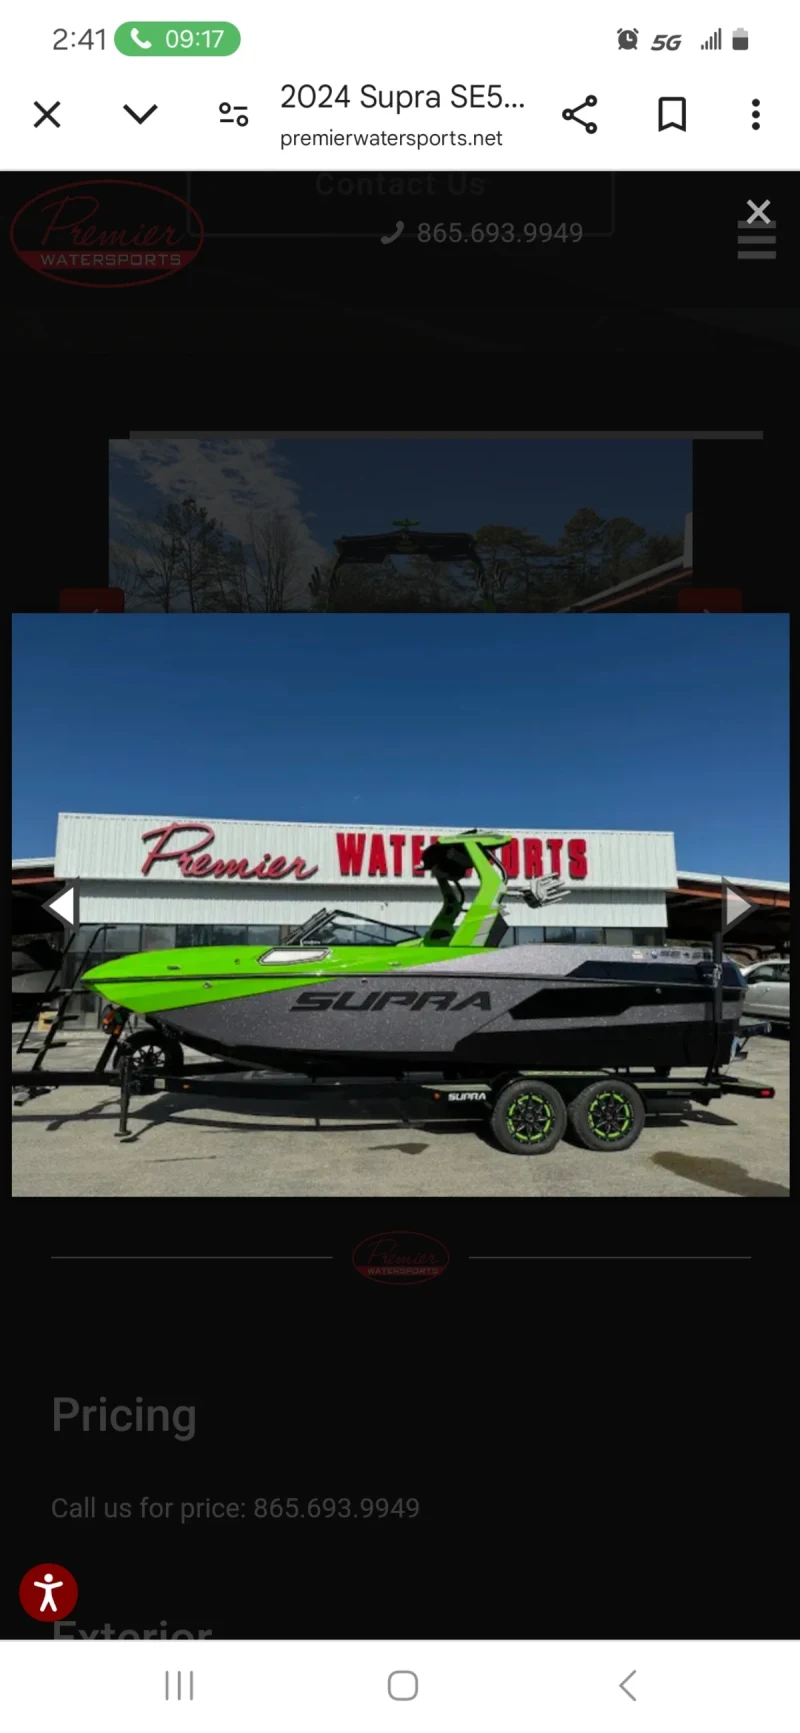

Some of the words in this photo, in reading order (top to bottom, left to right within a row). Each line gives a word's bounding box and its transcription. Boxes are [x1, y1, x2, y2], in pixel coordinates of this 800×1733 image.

[52, 28, 107, 52] 2:41
[165, 29, 225, 49] 09:17
[651, 33, 682, 52] 5G
[280, 84, 351, 109] 2024
[360, 83, 441, 115] Supra
[280, 129, 503, 151] premierwatersports.net
[315, 172, 436, 197] Contact
[447, 172, 486, 197] Us
[40, 196, 186, 248] Premier
[416, 222, 584, 243] 865.693.9949
[39, 251, 182, 267] WATERSPORTS
[140, 822, 318, 880] Premier
[335, 831, 588, 879] WATEORTS
[289, 990, 493, 1012] SUPRA
[447, 1091, 487, 1102] SUPRA
[367, 1237, 439, 1265] Premier
[367, 1266, 439, 1276] WATERSPORTS
[52, 1395, 198, 1442] Pricing
[51, 1496, 97, 1519] Call
[103, 1502, 133, 1519] us
[139, 1496, 174, 1519] for
[180, 1497, 247, 1524] price:
[253, 1497, 420, 1519] 865.693.9949
